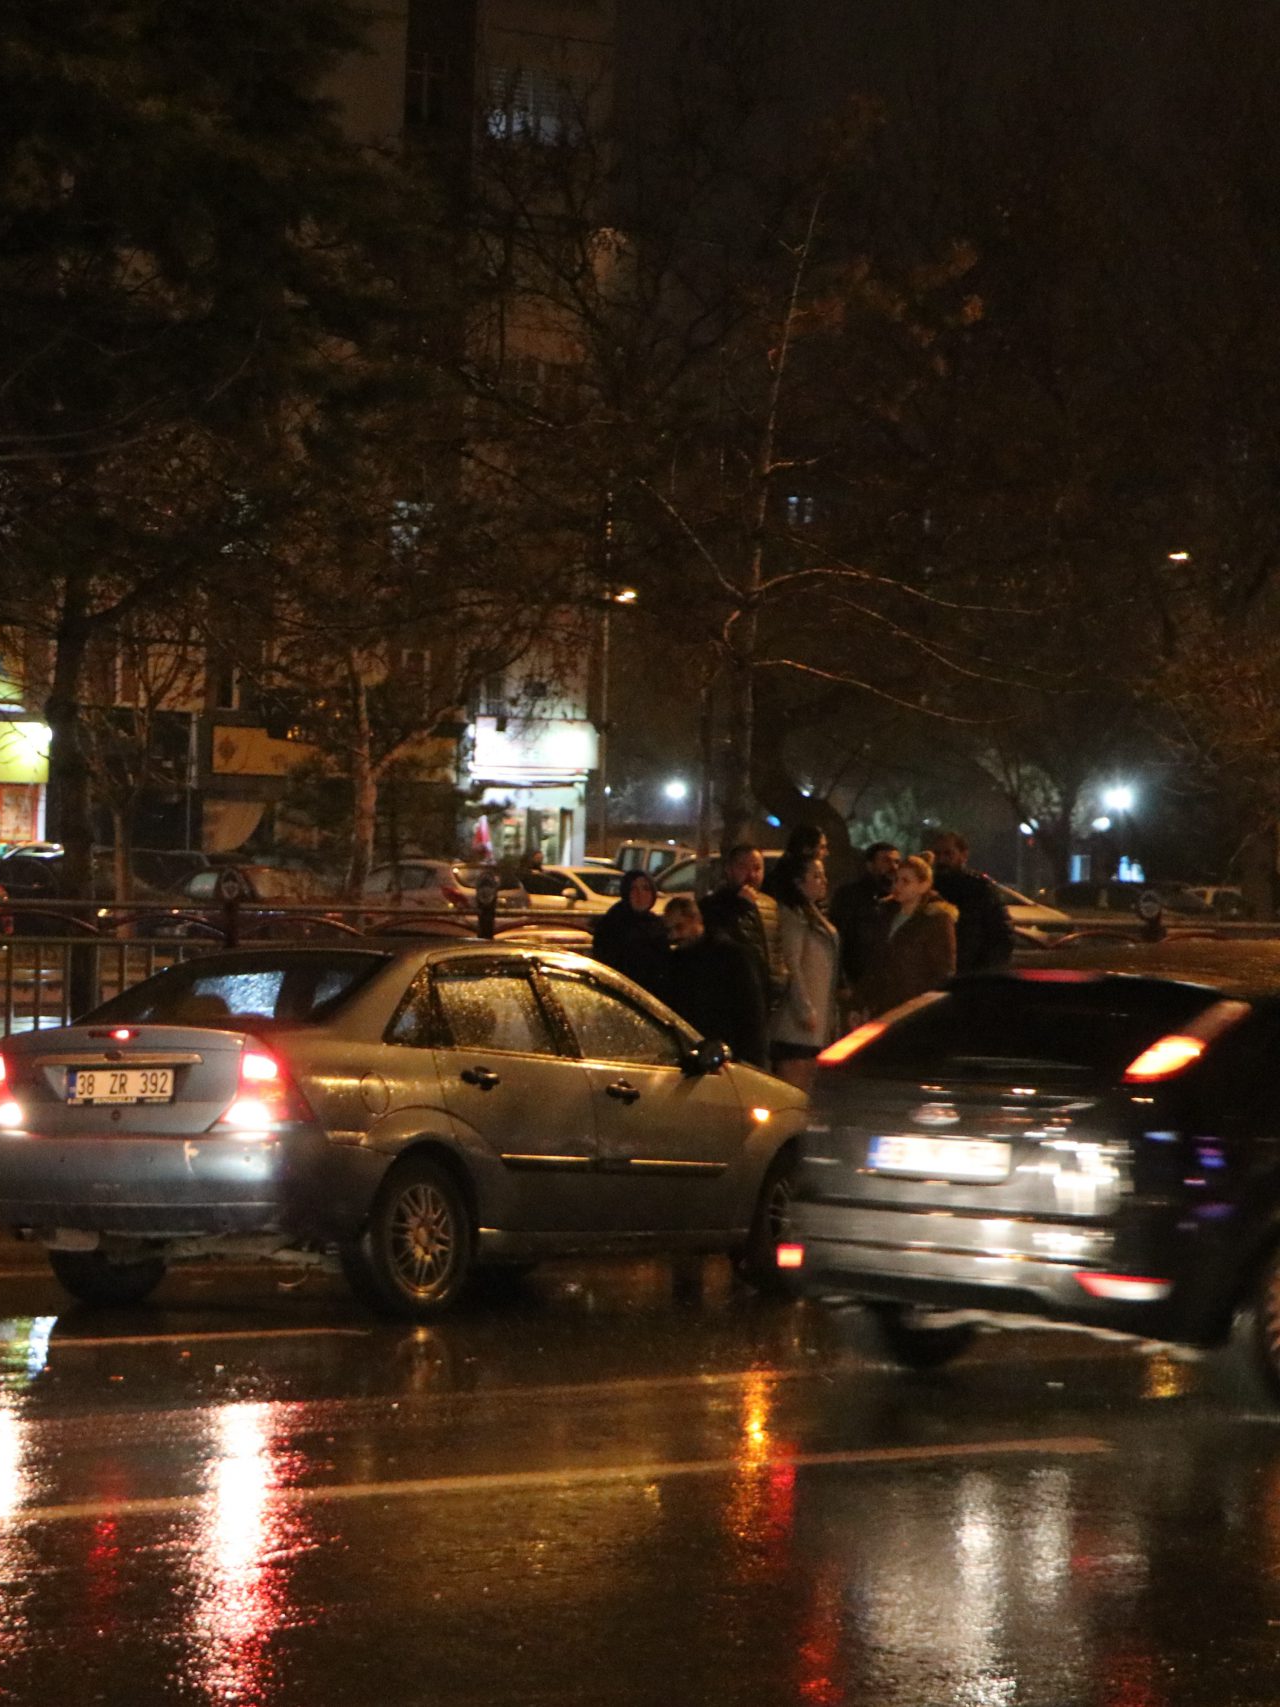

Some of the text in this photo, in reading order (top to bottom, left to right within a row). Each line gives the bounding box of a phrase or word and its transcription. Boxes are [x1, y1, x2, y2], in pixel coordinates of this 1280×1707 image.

[78, 1071, 168, 1095] 38 ZR 392
